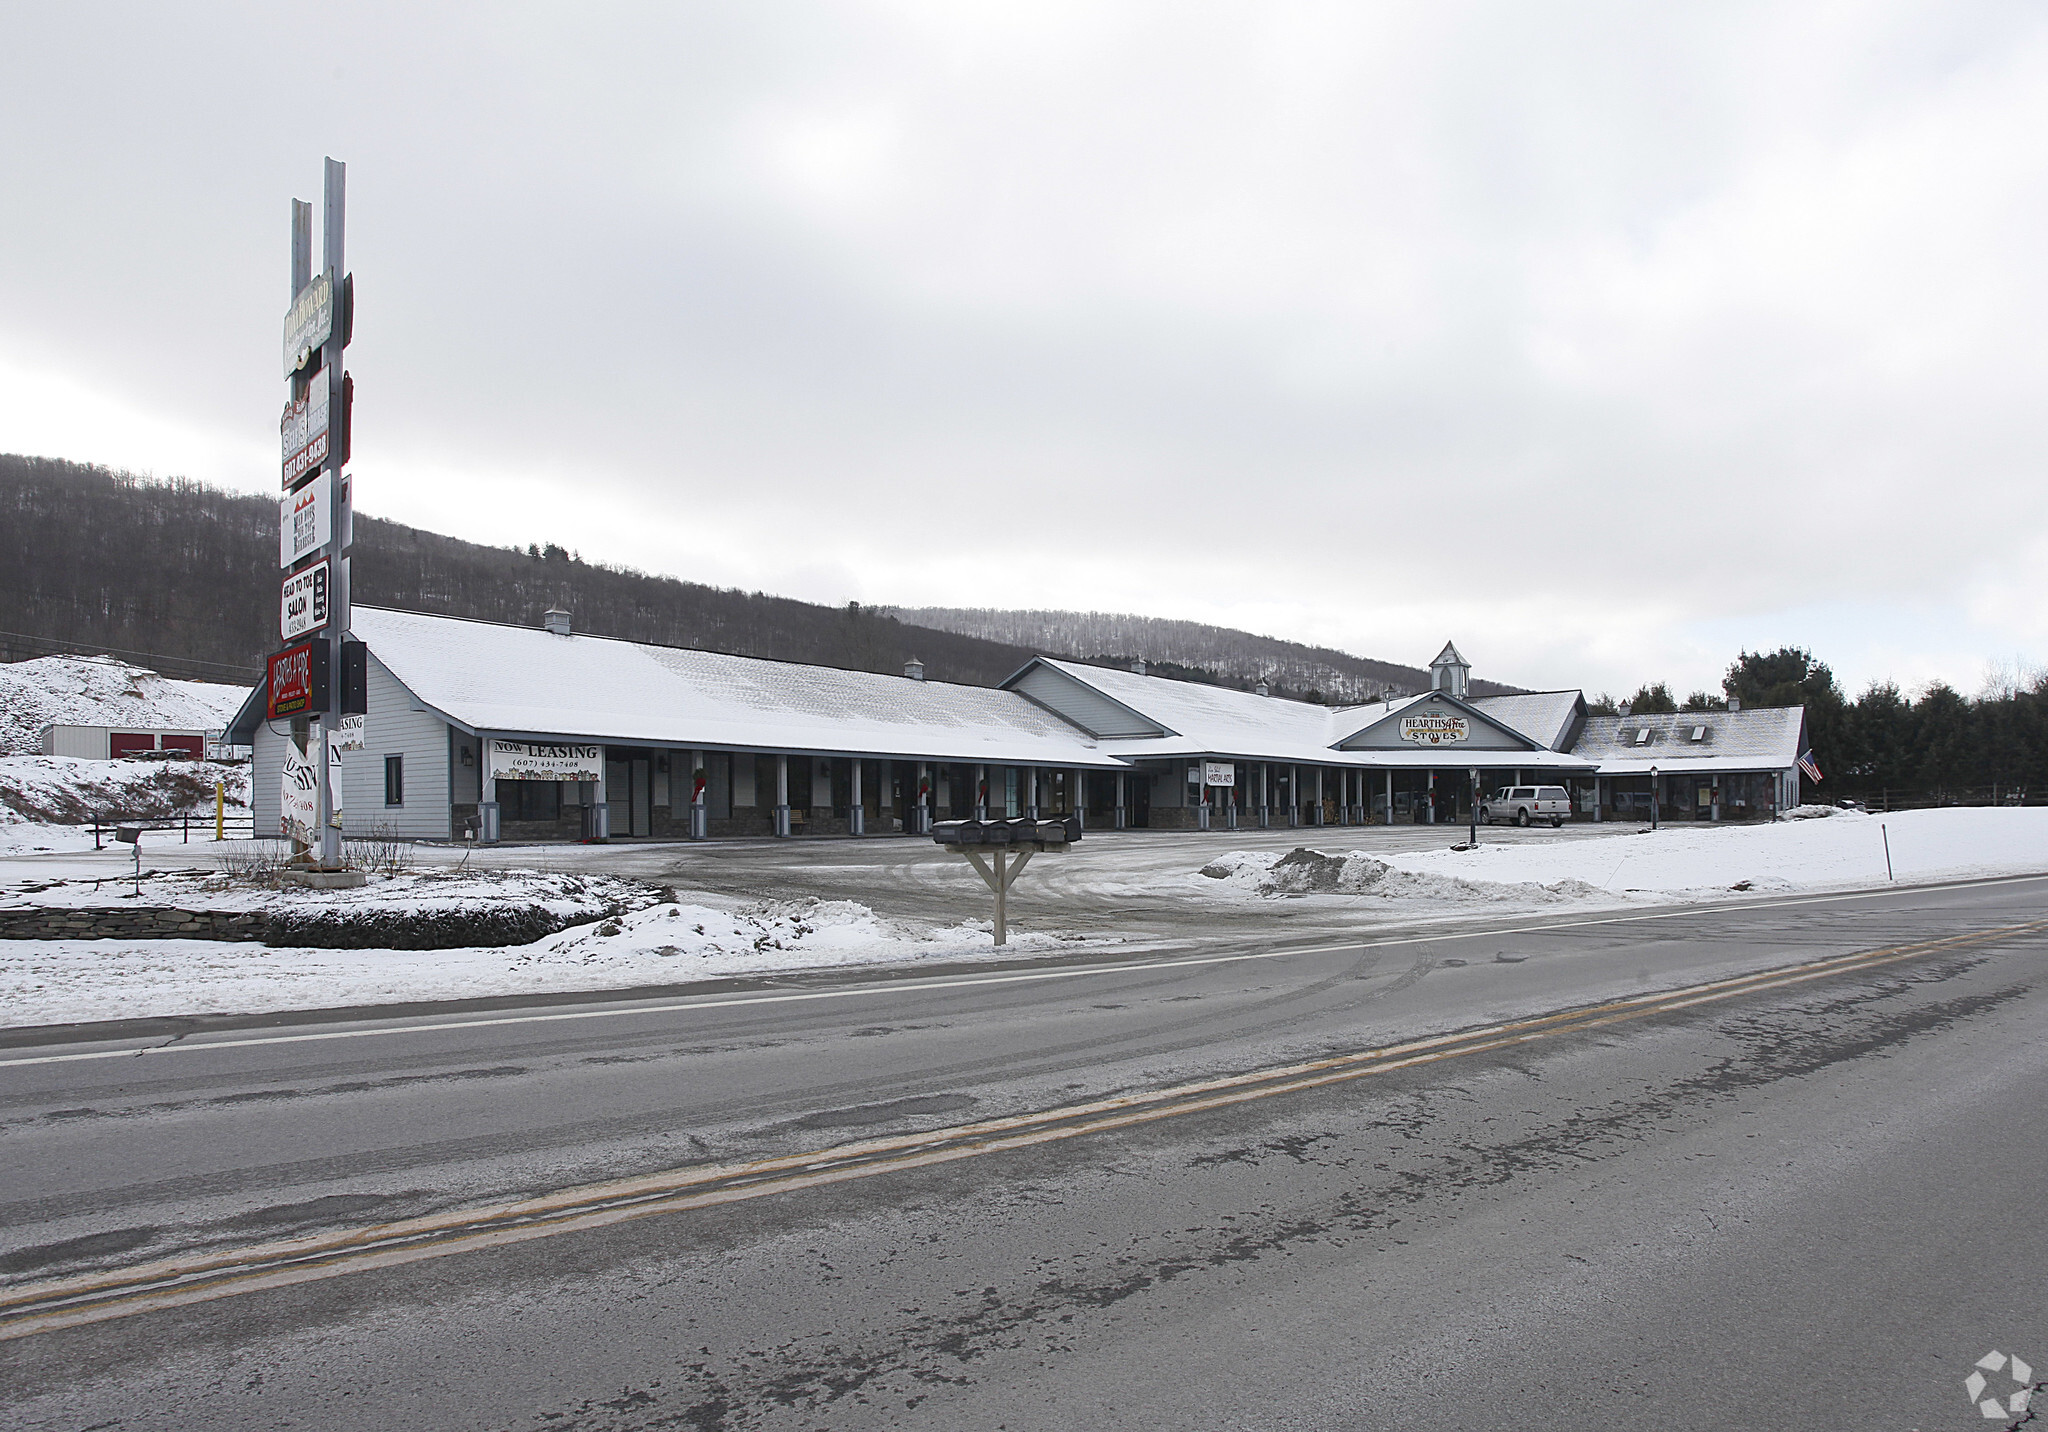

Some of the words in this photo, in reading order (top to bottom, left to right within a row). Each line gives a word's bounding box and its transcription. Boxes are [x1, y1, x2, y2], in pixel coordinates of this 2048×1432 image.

[283, 581, 295, 598] HEAD
[295, 578, 303, 592] TO
[303, 573, 313, 589] TOE
[288, 595, 307, 619] SALON
[341, 717, 363, 730] ASING
[1406, 719, 1446, 730] HEARTHS
[1412, 732, 1457, 740] STOVES
[494, 741, 523, 752] NOW
[528, 745, 598, 759] LEASING
[512, 759, 538, 768] (607)
[1208, 773, 1223, 783] MARTIAL
[1223, 773, 1233, 783] ARTS
